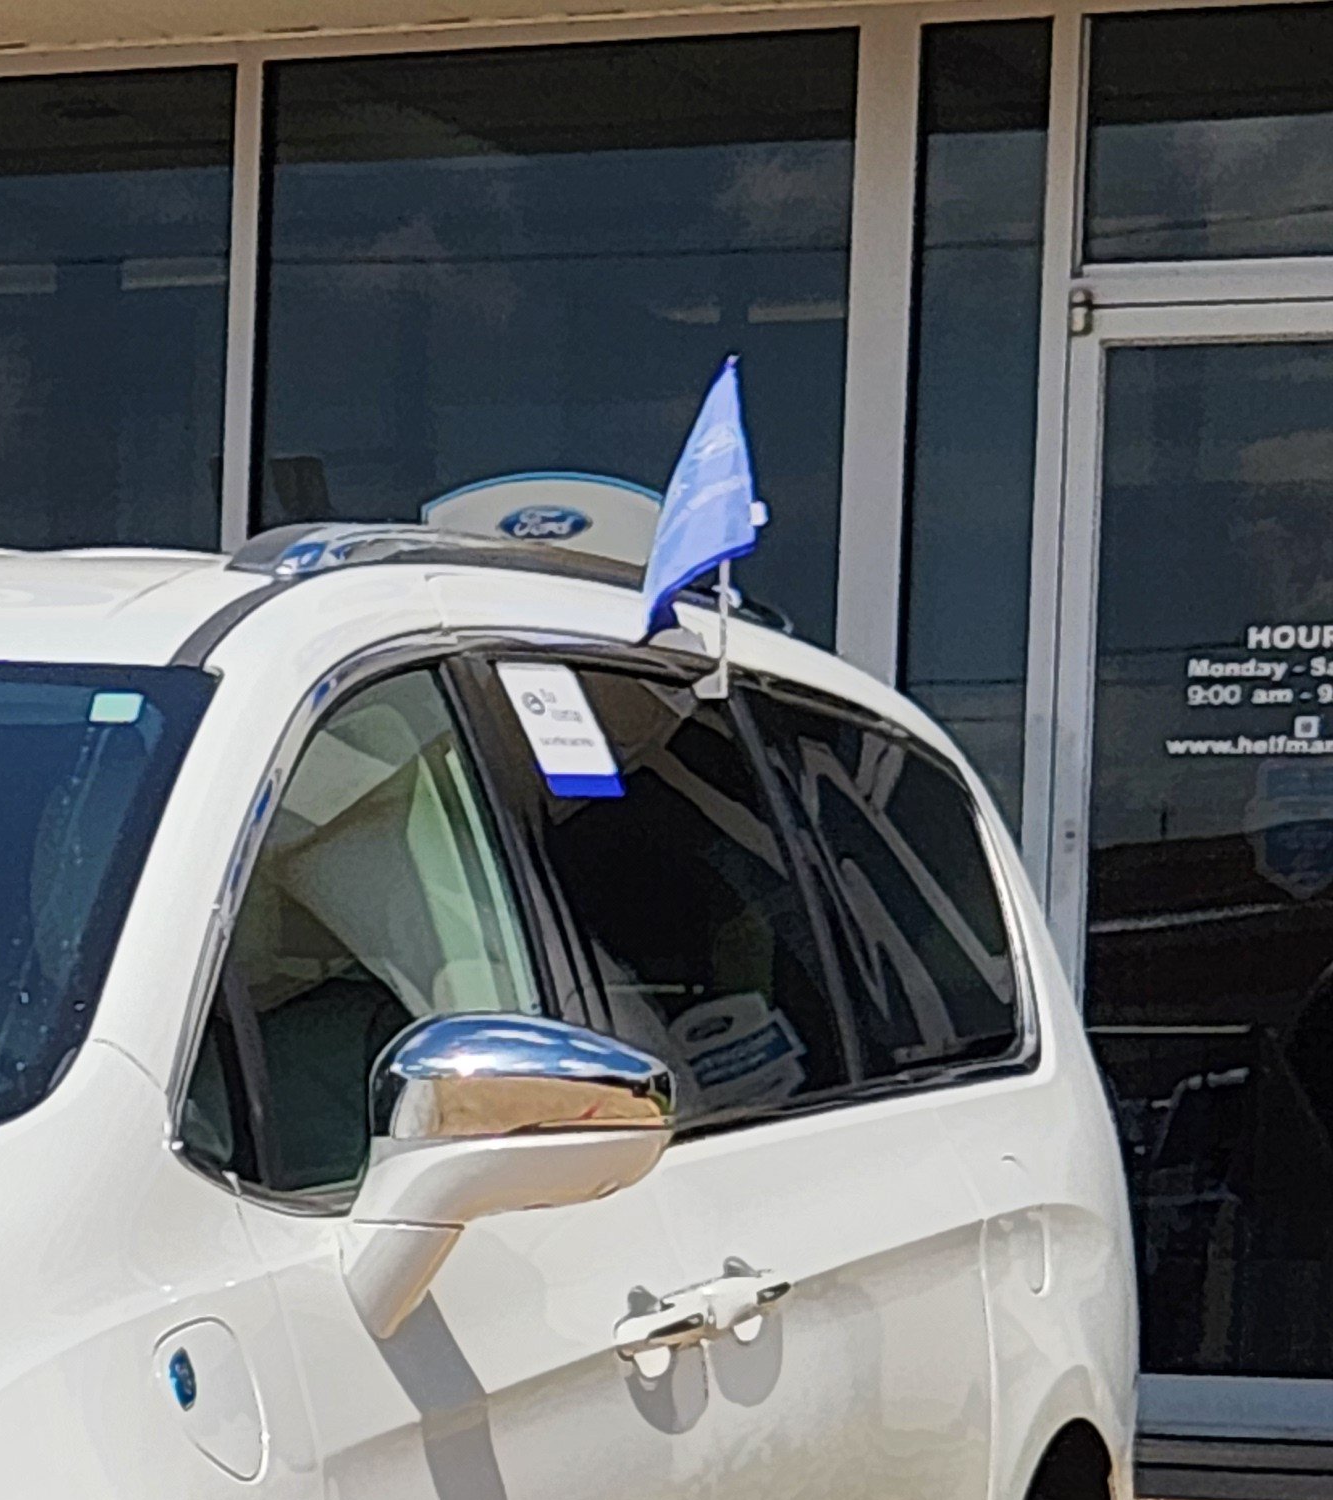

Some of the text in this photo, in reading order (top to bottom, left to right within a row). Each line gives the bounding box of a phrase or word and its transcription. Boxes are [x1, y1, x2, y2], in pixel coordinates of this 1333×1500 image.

[1187, 657, 1289, 682] Monday
[1186, 683, 1242, 706] 9:00
[1250, 687, 1295, 704] am
